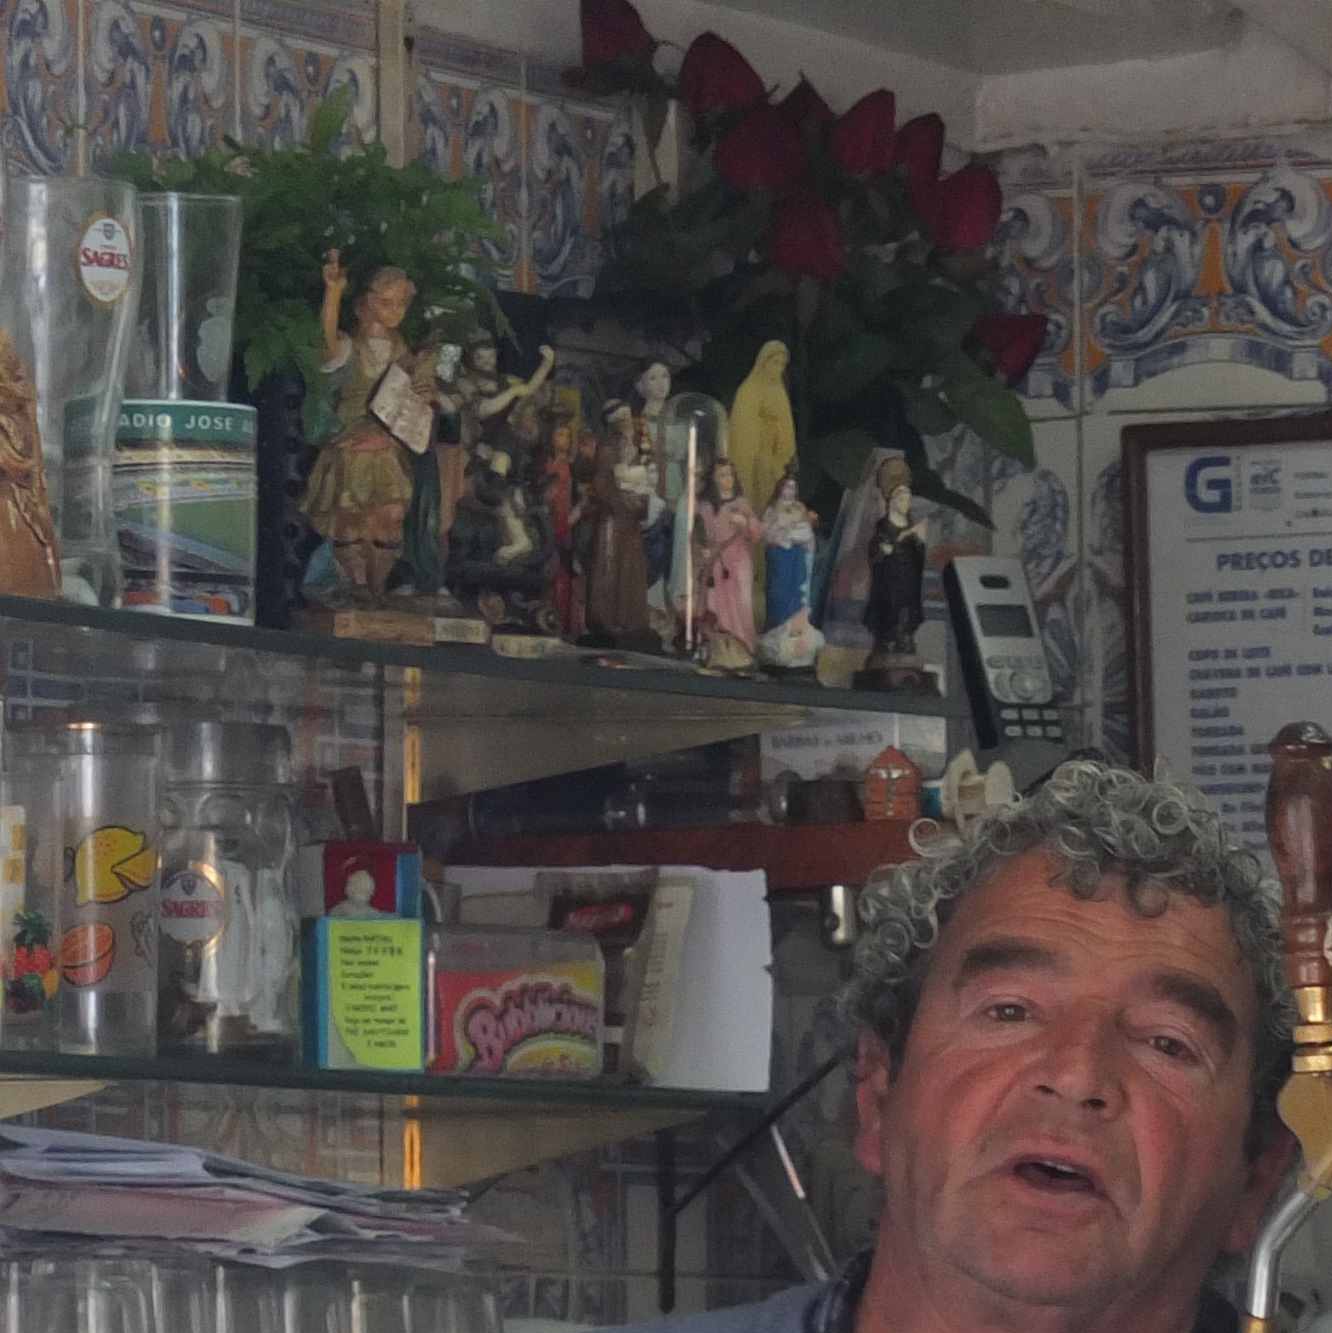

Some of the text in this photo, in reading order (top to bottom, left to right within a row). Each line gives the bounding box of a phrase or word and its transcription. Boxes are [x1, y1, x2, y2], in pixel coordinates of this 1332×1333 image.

[81, 247, 128, 270] SAGRES
[118, 412, 171, 428] ADIO
[184, 414, 233, 431] JOSE
[1185, 455, 1233, 513] G
[1216, 550, 1301, 574] PREÇOS
